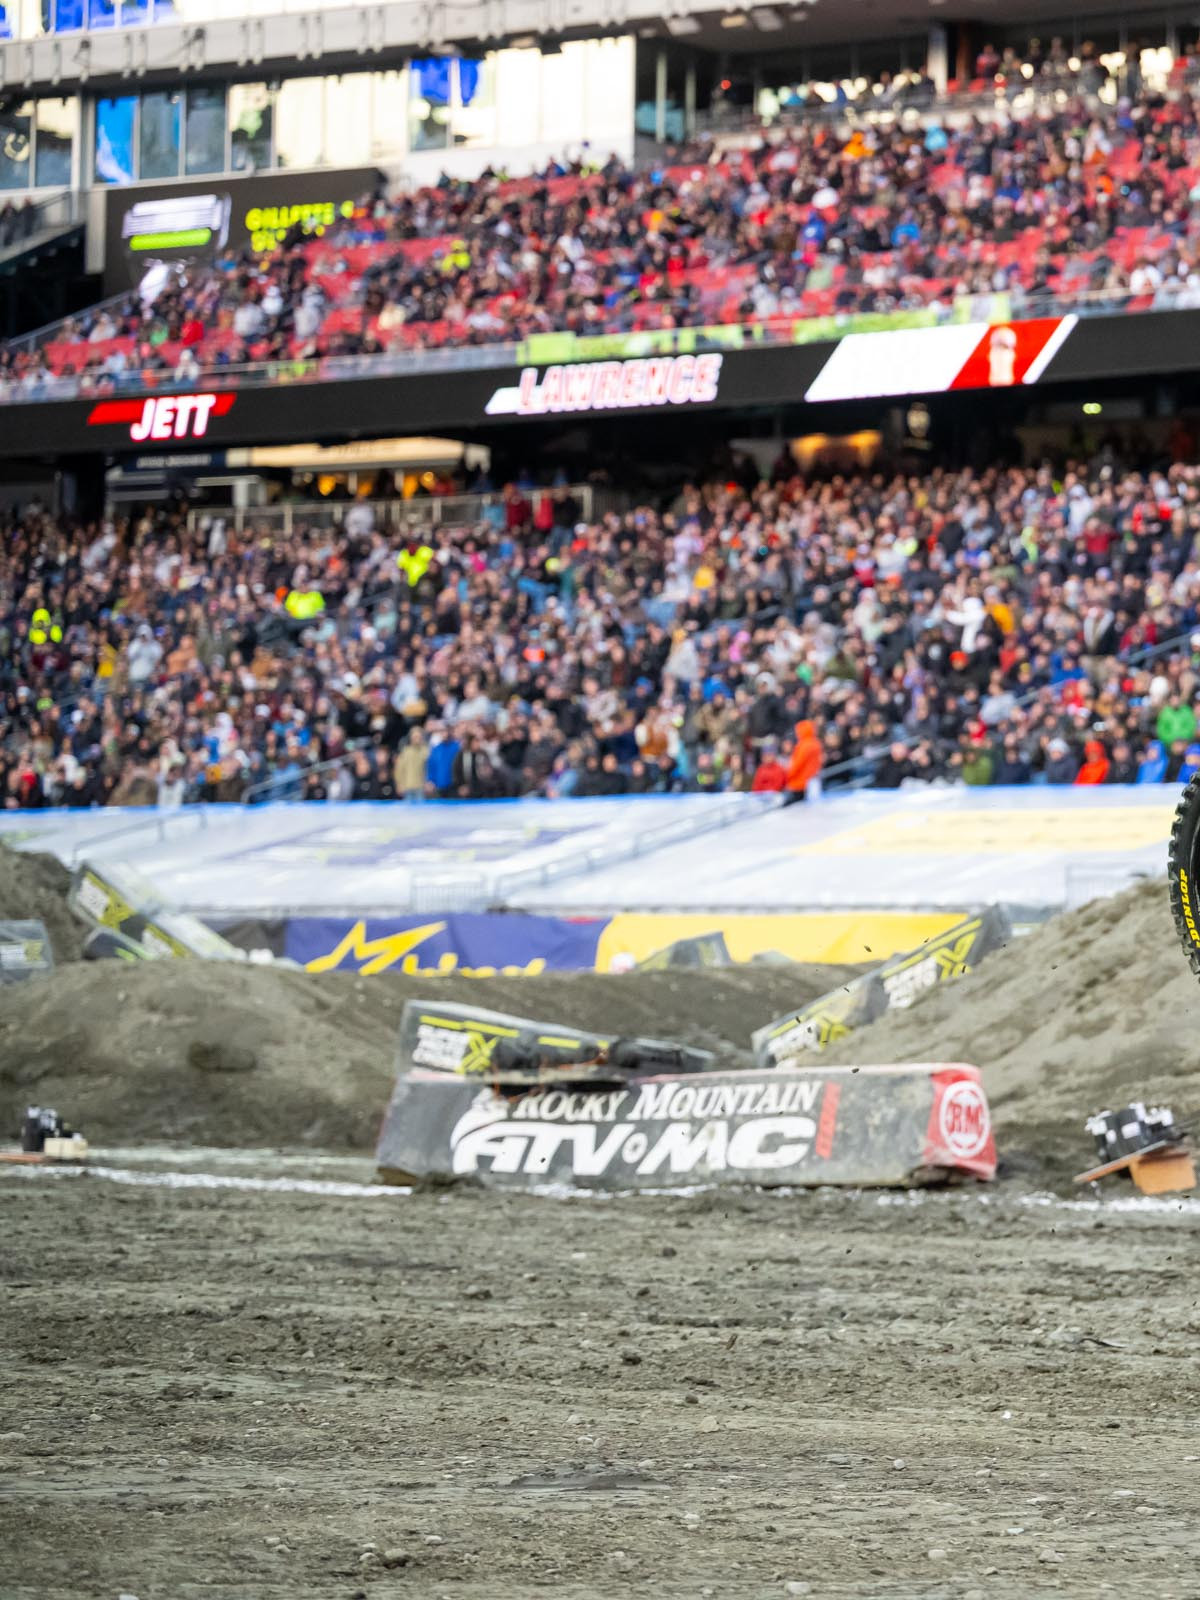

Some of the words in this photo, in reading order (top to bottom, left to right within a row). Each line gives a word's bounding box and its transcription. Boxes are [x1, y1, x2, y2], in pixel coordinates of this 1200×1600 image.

[516, 353, 723, 415] LAWRENCE
[131, 394, 216, 441] JETT
[1179, 868, 1200, 943] DUNLOP
[513, 1090, 631, 1122] ROCKY
[627, 1080, 823, 1121] MOUNTAIN
